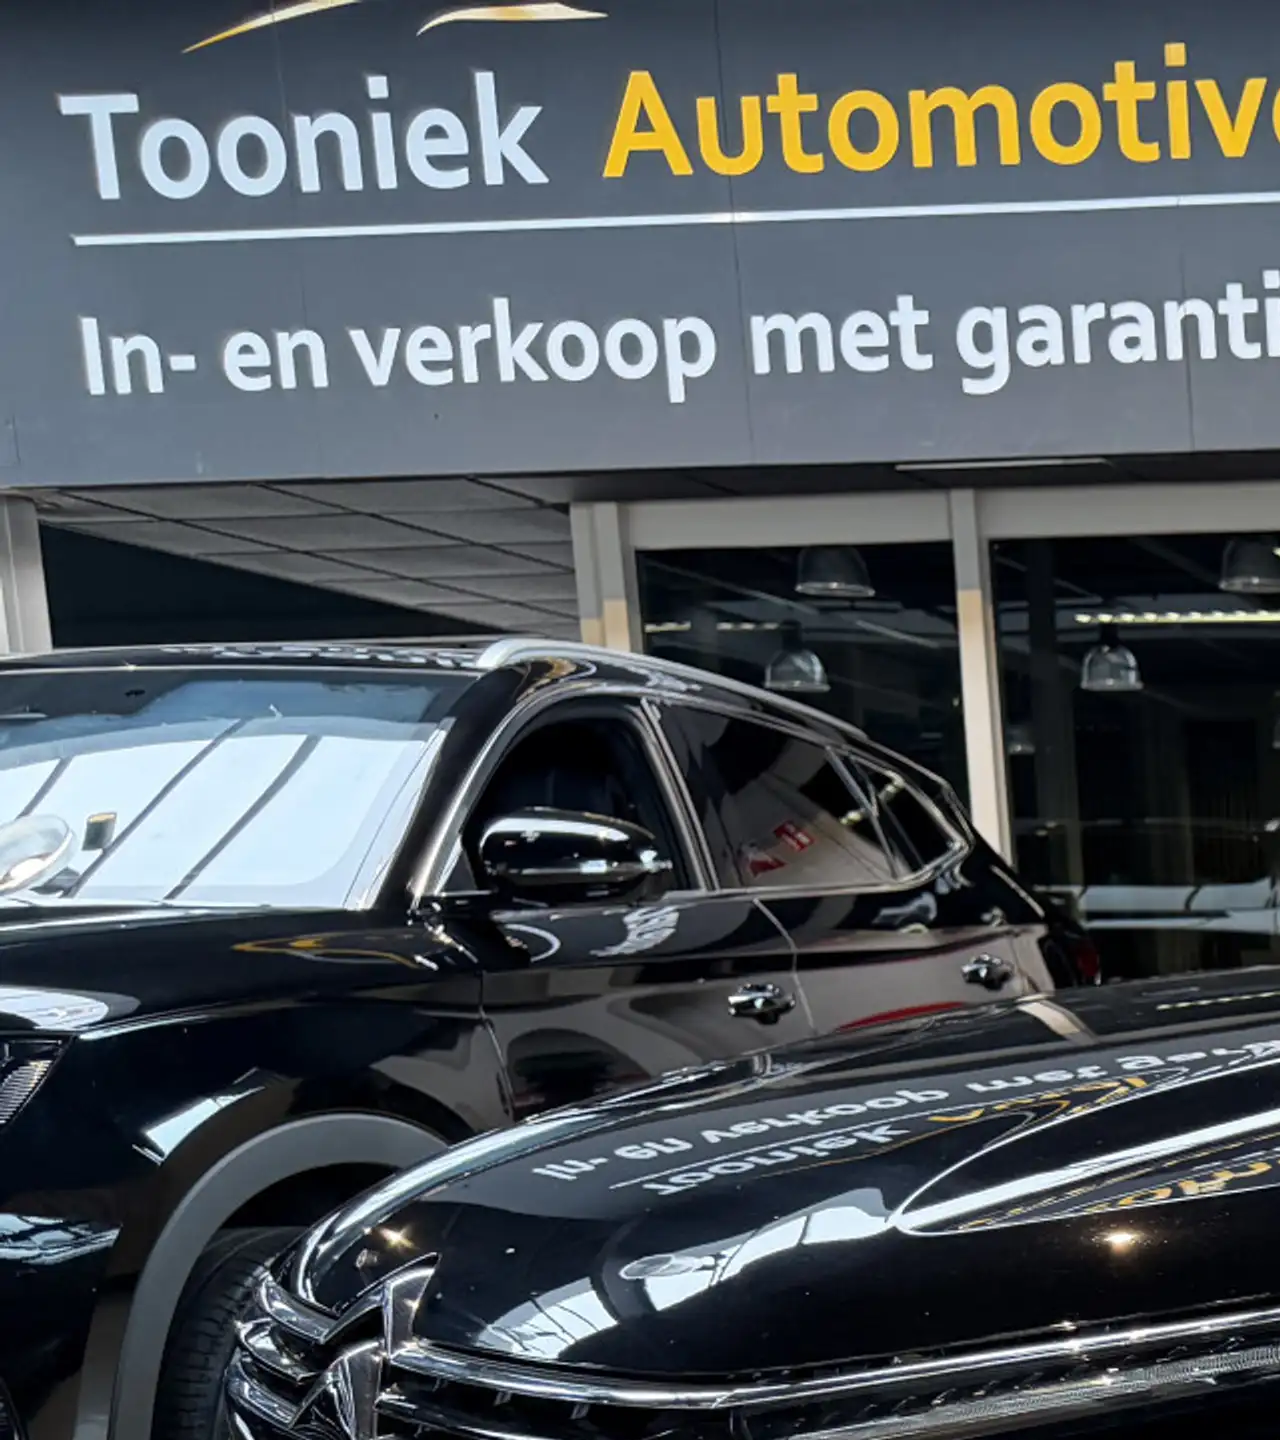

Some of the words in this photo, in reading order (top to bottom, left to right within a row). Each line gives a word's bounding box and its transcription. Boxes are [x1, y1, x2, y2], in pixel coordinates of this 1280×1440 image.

[58, 72, 549, 200] Tooniek
[80, 317, 197, 396] In-
[223, 331, 329, 393] en
[348, 297, 716, 405] verkoop
[750, 296, 935, 375] met
